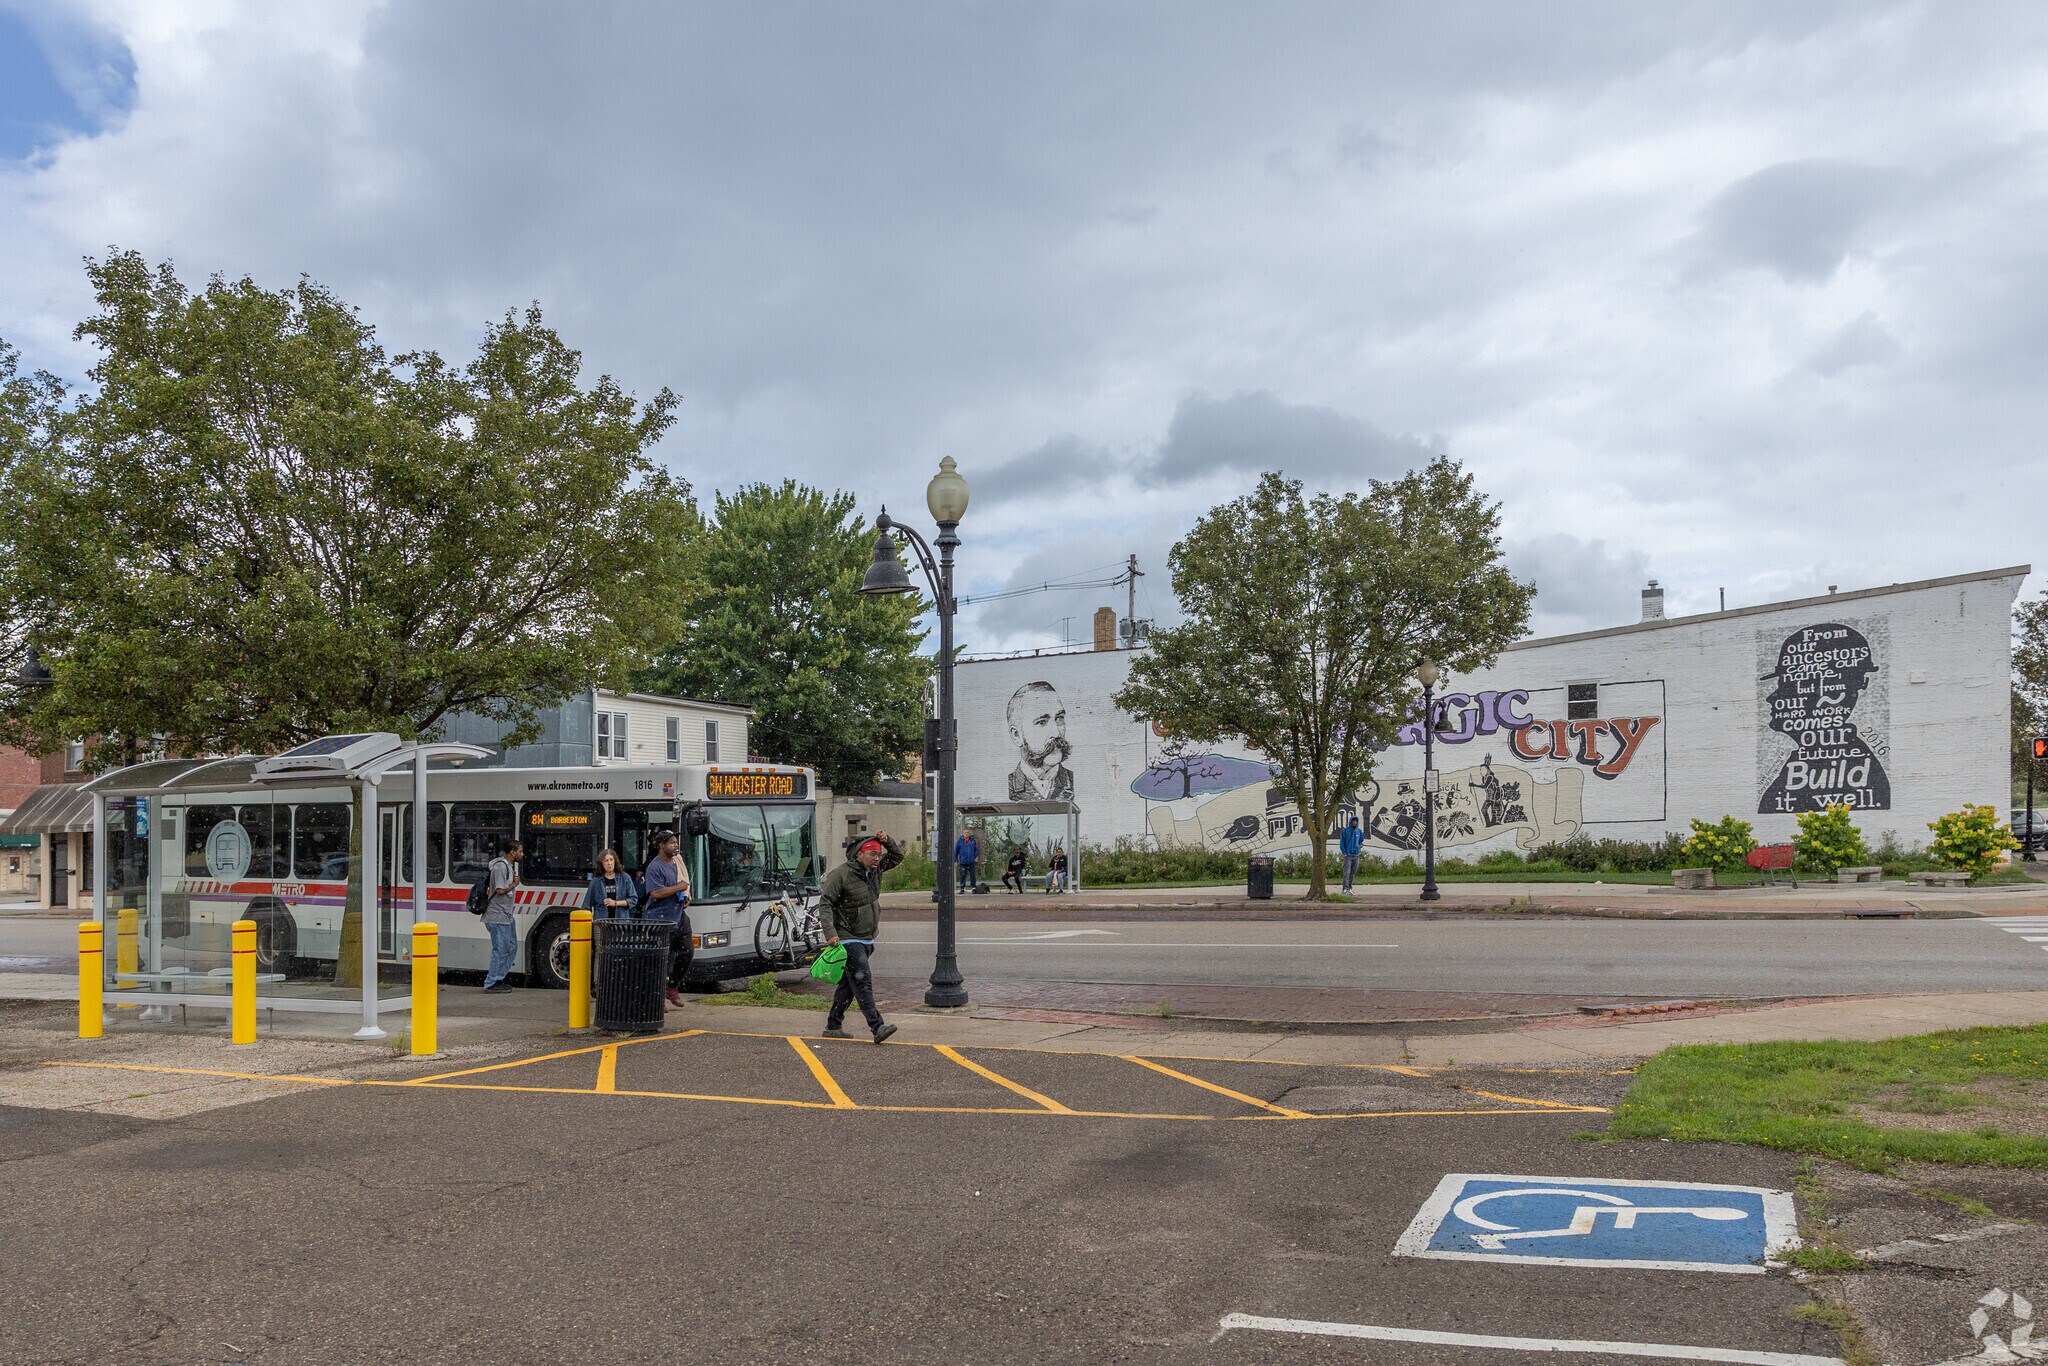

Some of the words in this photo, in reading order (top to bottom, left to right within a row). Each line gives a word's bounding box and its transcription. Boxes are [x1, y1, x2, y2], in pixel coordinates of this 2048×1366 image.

[1802, 629, 1849, 642] From
[1787, 641, 1817, 654] our
[1782, 646, 1869, 667] ancestors
[1786, 661, 1829, 674] came
[1835, 657, 1865, 669] our
[1783, 669, 1842, 682] name,
[1797, 681, 1816, 694] but
[1819, 678, 1847, 697] from
[1774, 697, 1808, 710] our
[1774, 709, 1807, 719] HARD
[1812, 706, 1852, 717] WORK
[1783, 715, 1844, 732] comes
[1800, 728, 1852, 747] our
[1860, 726, 1890, 756] 2016
[1508, 716, 1662, 780] CITY
[1797, 747, 1871, 760] future.
[1785, 757, 1871, 791] Build
[527, 780, 609, 792] www.akronmetro.org
[634, 780, 653, 790] 1816
[724, 775, 767, 795] WOOSTER
[769, 775, 793, 795] ROAD
[1775, 792, 1797, 812] it
[1812, 788, 1881, 809] well.
[531, 814, 544, 825] 8W
[550, 816, 588, 824] BARBERTON
[272, 883, 306, 896] METRO
